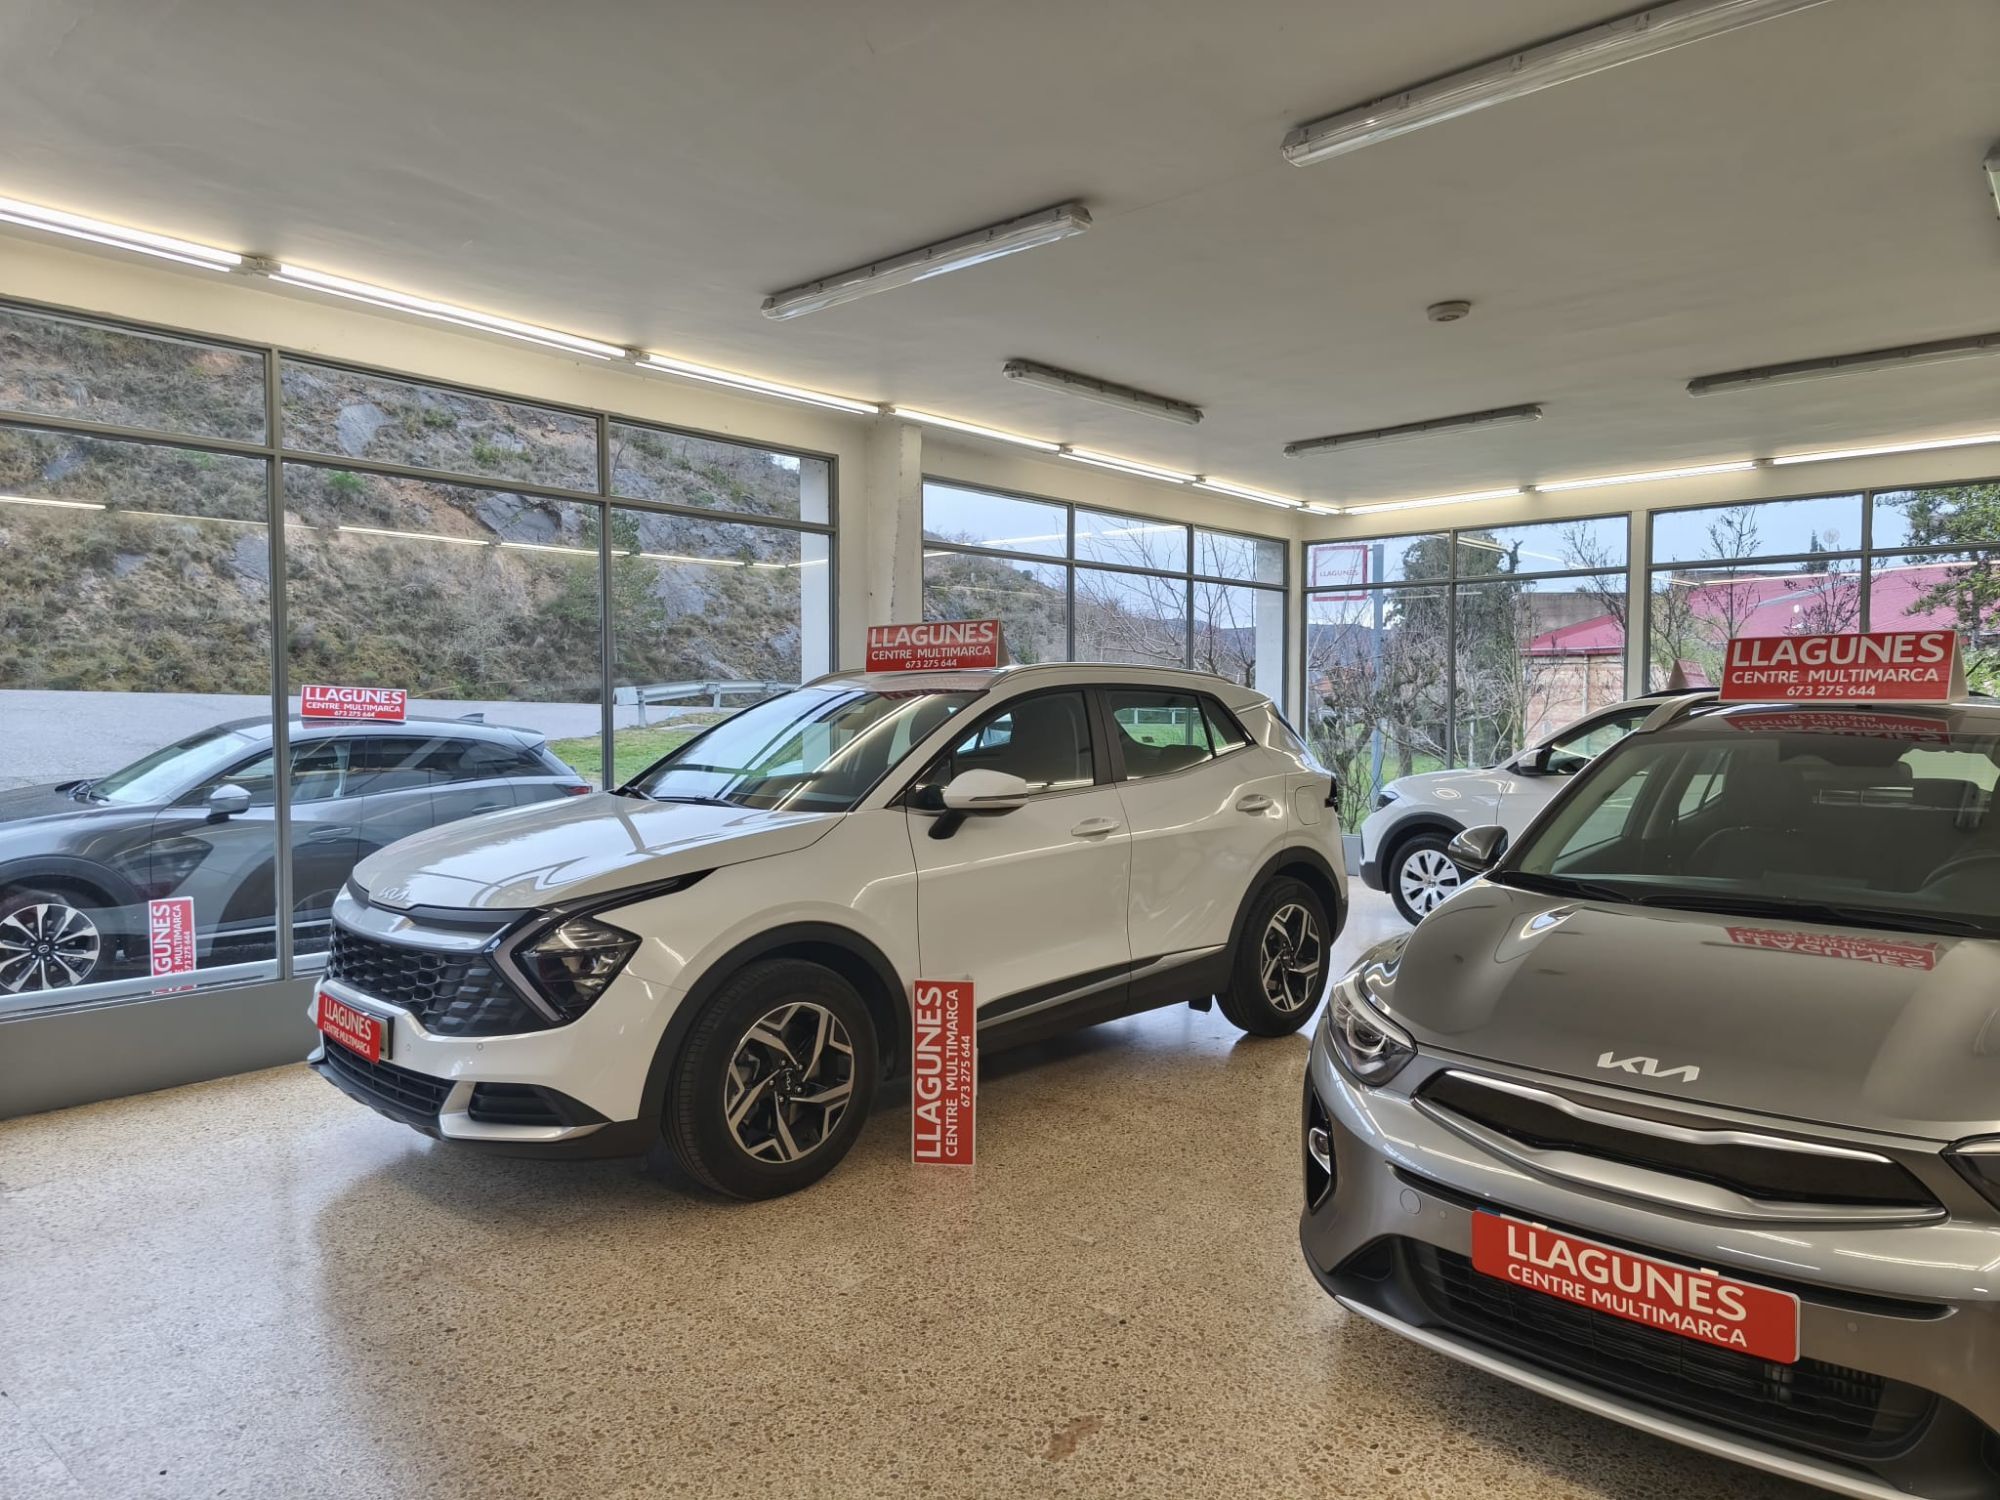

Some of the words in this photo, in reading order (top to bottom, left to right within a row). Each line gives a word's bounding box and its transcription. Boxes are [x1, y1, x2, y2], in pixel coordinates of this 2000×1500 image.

[871, 622, 993, 648] LLAGUNES
[1731, 633, 1945, 667] LLAGUNES
[872, 649, 912, 660] CENTRE
[917, 646, 991, 659] MULTIMARCA
[905, 661, 921, 669] 673
[923, 660, 939, 668] 275
[941, 659, 957, 667] 644
[1732, 671, 1798, 684] CENTRE
[1808, 668, 1939, 683] MULTIMARCA
[1786, 685, 1813, 696] 673
[1816, 685, 1843, 696] 275
[1848, 685, 1876, 696] 644
[306, 687, 402, 704] LLAGUNES
[306, 702, 340, 710] CENTRE
[344, 703, 401, 712] MULTIMARCA
[152, 904, 173, 975] GUNES
[172, 904, 184, 965] MULTIMARCA
[324, 997, 372, 1041] LLAGUNES
[323, 1020, 340, 1038] CENTRE
[340, 1030, 371, 1056] MULTIMARCA
[946, 989, 959, 1090] MULTIMARCA
[961, 1035, 971, 1058] 644
[917, 986, 942, 1158] LLAGUNES
[961, 1060, 971, 1083] 275
[1597, 1051, 1700, 1082] KIA
[961, 1085, 971, 1108] 673
[946, 1098, 958, 1157] CENTRE
[1507, 1225, 1748, 1322] LLAGUNES
[1507, 1263, 1586, 1301] CENTRE
[1592, 1288, 1748, 1348] MULTIMARCA
